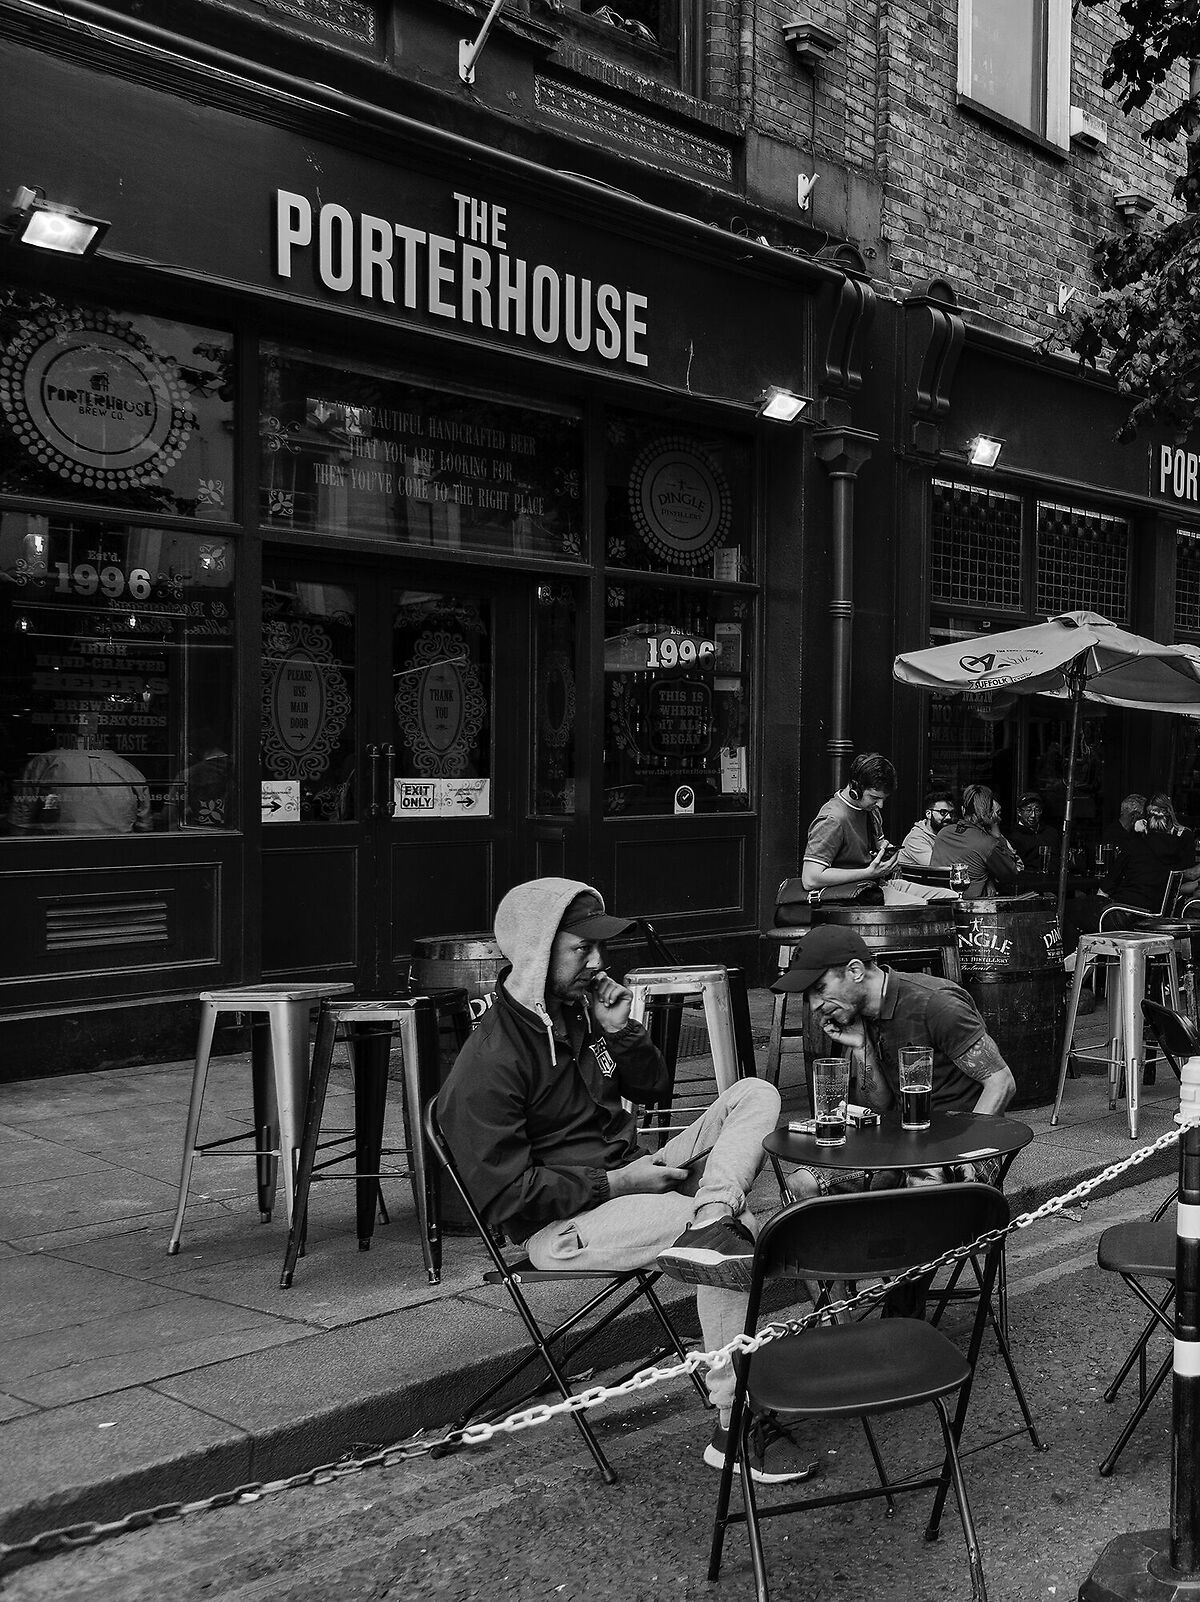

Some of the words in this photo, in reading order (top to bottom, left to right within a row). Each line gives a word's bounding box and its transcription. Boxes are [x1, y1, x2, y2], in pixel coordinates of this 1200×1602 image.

[453, 192, 507, 250] THE
[277, 189, 648, 367] PORTERHOUSE
[47, 384, 153, 417] PORTERHOUSE
[79, 405, 107, 417] BREW
[111, 411, 125, 421] CO.
[362, 404, 424, 436] BEAUTIFUL
[429, 416, 505, 450] HANDCRAFTED
[511, 432, 536, 457] BEER
[349, 436, 377, 460] THAT
[384, 440, 407, 463] YOU
[414, 446, 435, 470] ARE
[440, 450, 487, 478] LOOKING
[313, 463, 345, 487] THEN
[350, 467, 393, 494] YOU'VE
[399, 475, 429, 500] COME
[434, 480, 448, 503] TO
[453, 483, 473, 506] THE
[478, 487, 510, 511] RIGHT
[514, 493, 545, 517] PLACE
[658, 492, 706, 513] DINGLE
[54, 562, 151, 599] 1996
[80, 643, 128, 656] IRISH
[646, 637, 715, 671] 1996
[35, 654, 167, 672] HAND-CRAFTED
[287, 669, 313, 681] PLEASE
[32, 672, 169, 694] BEERS
[975, 677, 1009, 690] SUFFOLK
[293, 686, 307, 697] USE
[430, 688, 454, 702] THANK
[659, 690, 686, 702] THIS
[692, 691, 704, 702] IS
[53, 699, 125, 712] BREWED
[132, 701, 150, 713] IN
[290, 702, 308, 713] MAIN
[435, 707, 448, 719] YOU
[660, 705, 702, 716] WHERE
[32, 712, 88, 725] SMALL
[97, 714, 167, 727] BATCHES
[290, 718, 309, 729] DOOR
[115, 734, 148, 750] TASTE
[661, 733, 701, 745] BEGAN
[404, 786, 431, 796] EXIT
[403, 798, 432, 808] ONLY
[958, 932, 1014, 955] NGLE
[1043, 927, 1062, 948] DIN
